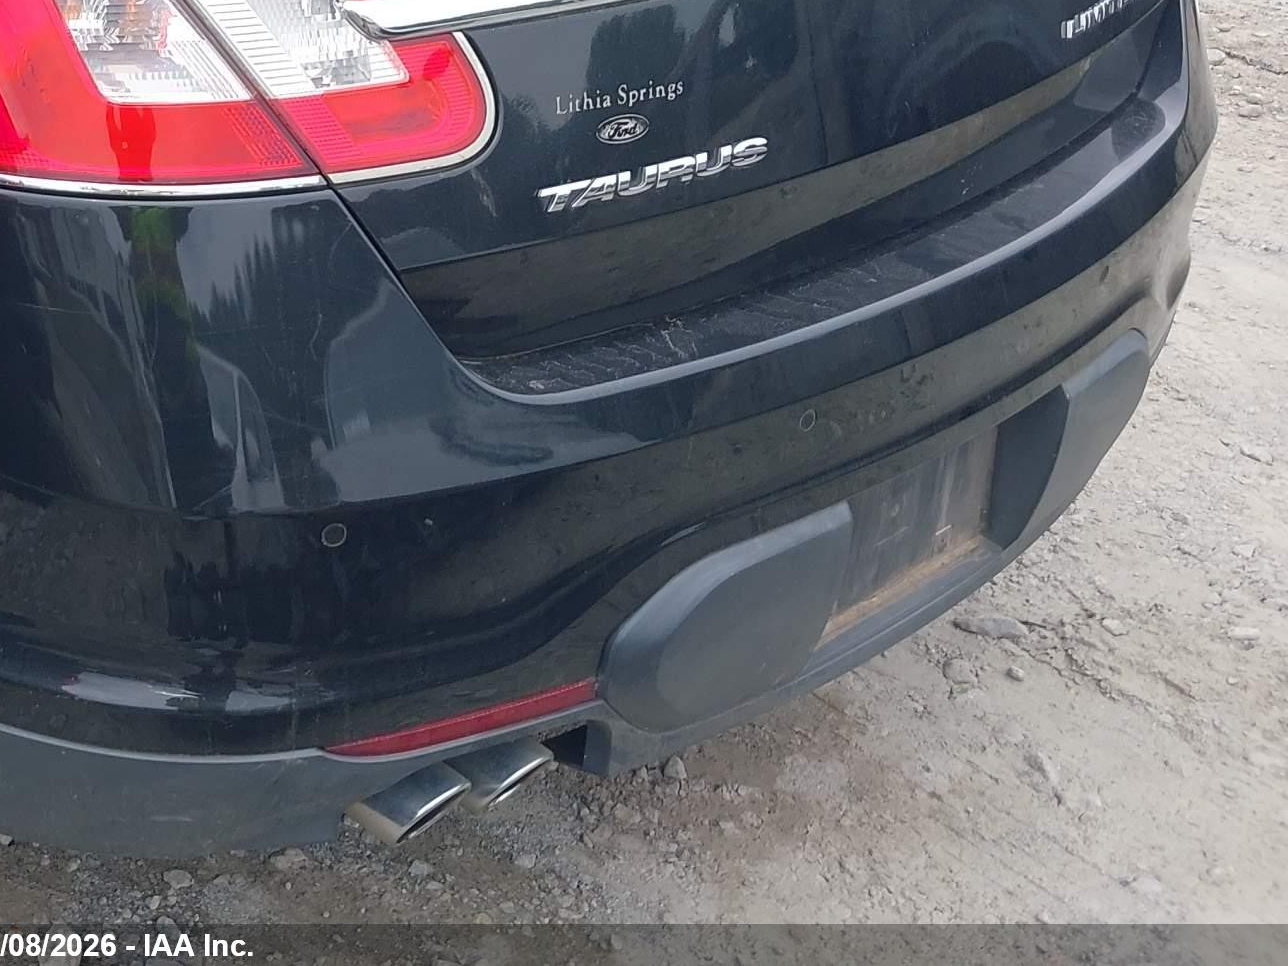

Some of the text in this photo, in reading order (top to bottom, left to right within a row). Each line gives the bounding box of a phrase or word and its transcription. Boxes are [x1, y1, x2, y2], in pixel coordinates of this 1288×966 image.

[555, 80, 684, 115] Lithia Springs
[536, 136, 769, 213] TAURUS
